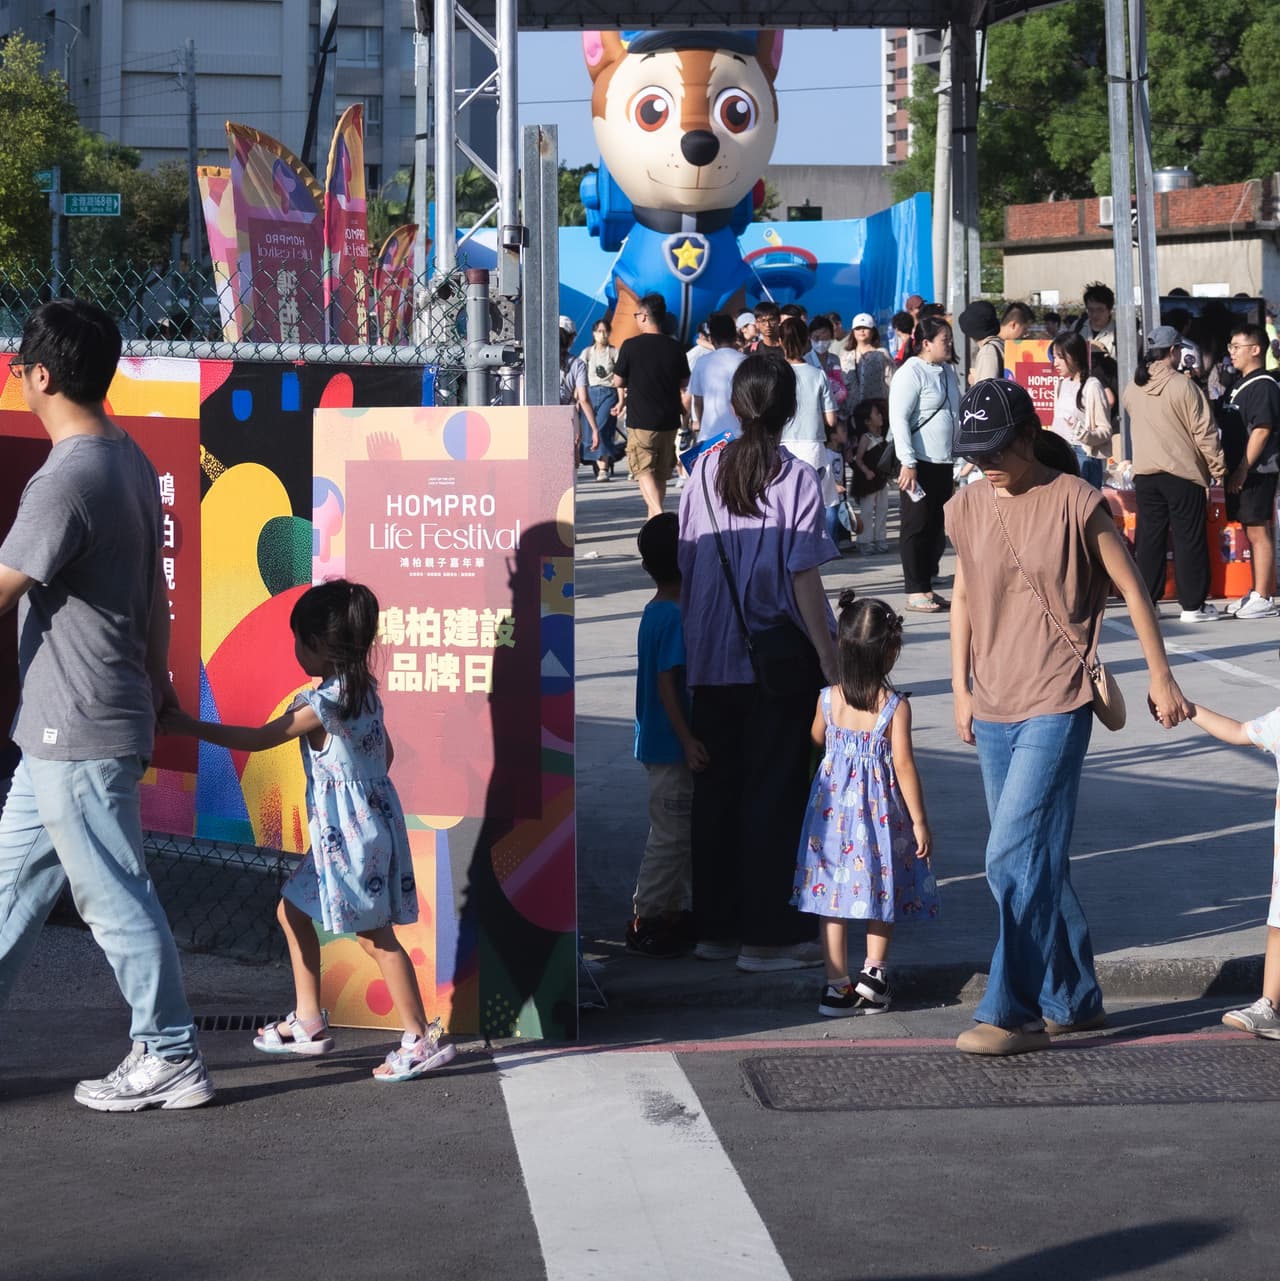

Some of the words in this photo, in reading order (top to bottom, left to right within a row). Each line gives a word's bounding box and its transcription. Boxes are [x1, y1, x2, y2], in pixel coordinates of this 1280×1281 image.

[386, 494, 496, 517] HOMPRO
[370, 523, 414, 550] Life
[421, 520, 521, 550] Festival
[375, 606, 516, 648] 鴻柏建設
[388, 652, 494, 693] 品牌日
